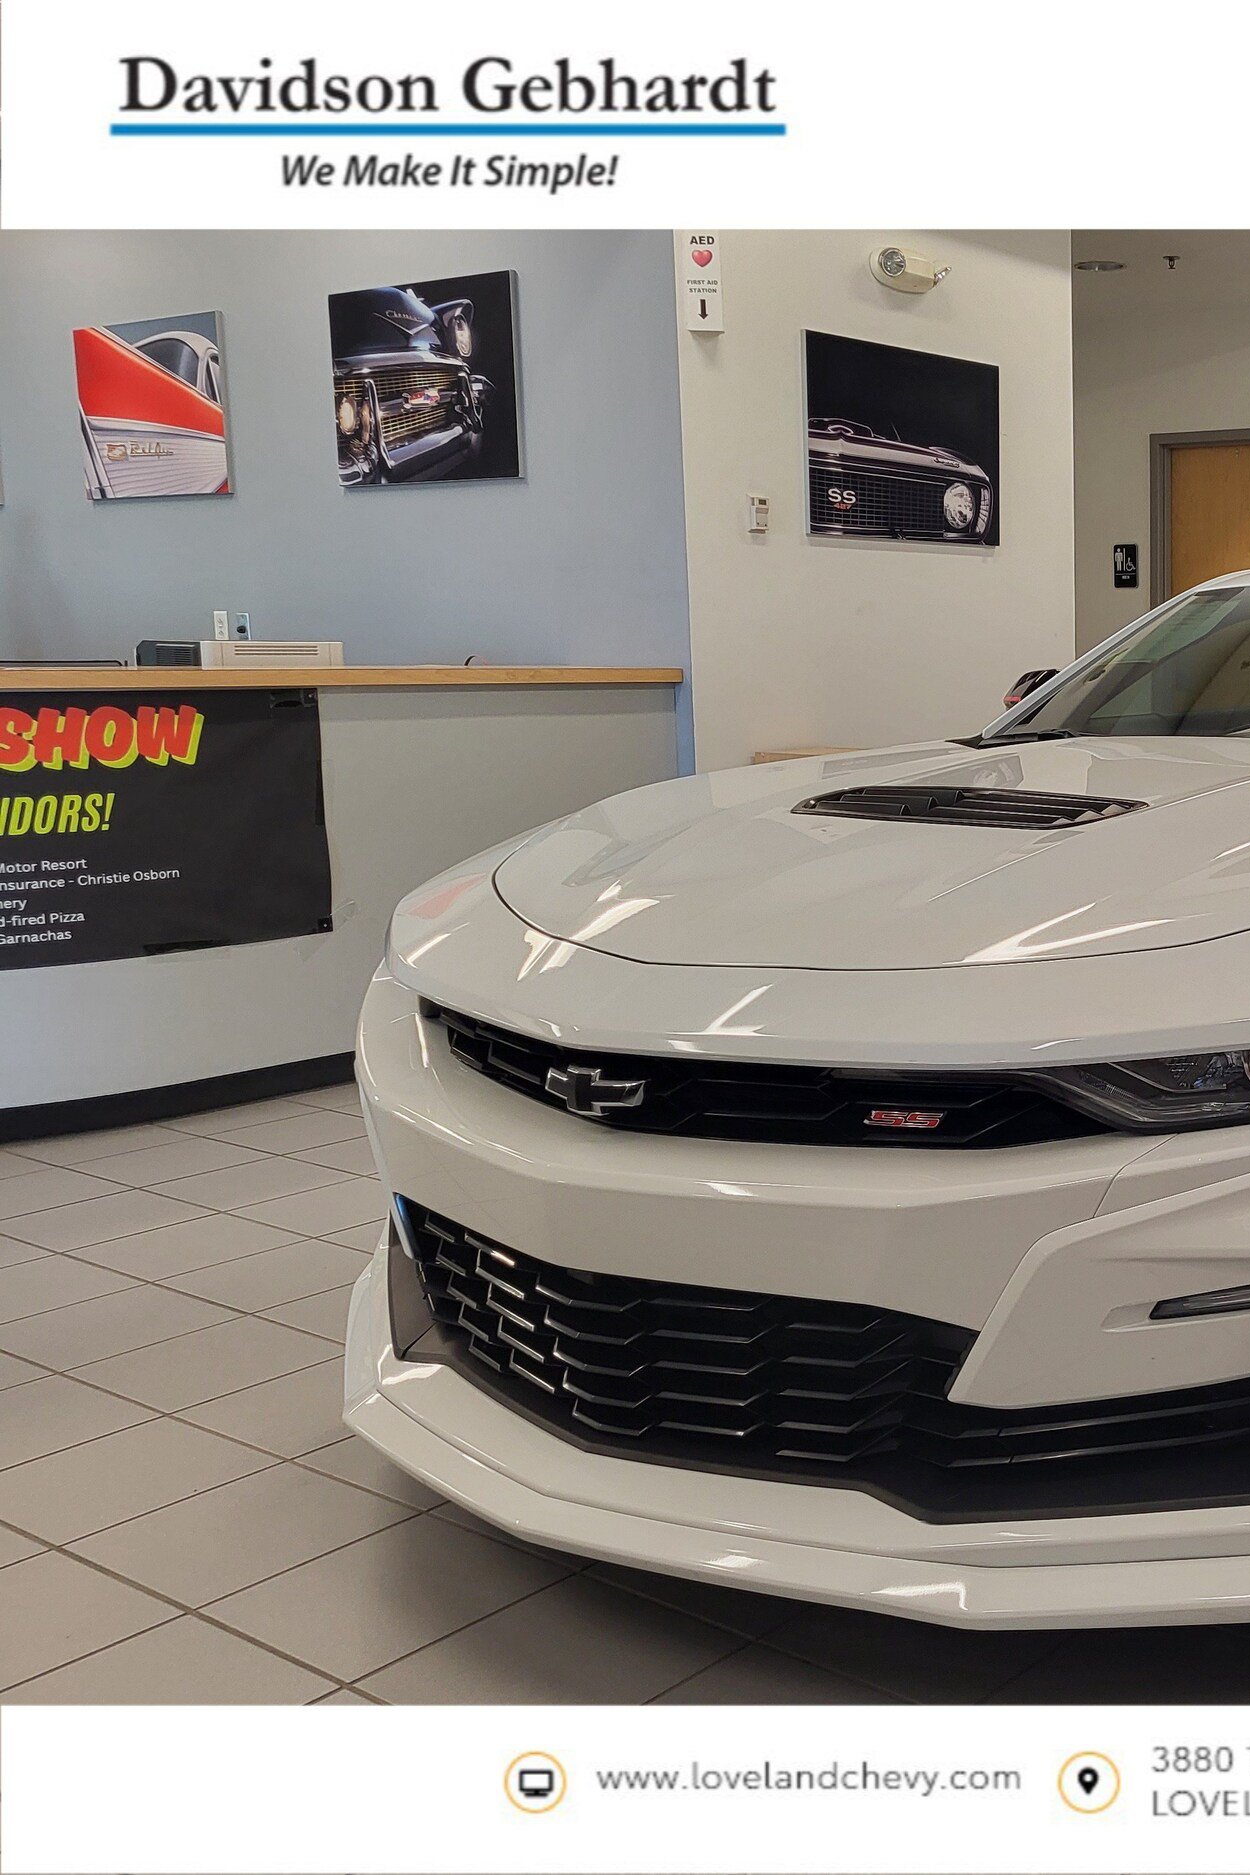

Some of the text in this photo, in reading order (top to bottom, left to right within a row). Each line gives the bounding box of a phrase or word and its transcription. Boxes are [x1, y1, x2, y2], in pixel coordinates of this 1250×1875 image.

[690, 236, 715, 245] AED
[828, 488, 856, 504] SS
[0, 705, 204, 772] SHOW
[41, 858, 87, 871] Resort
[78, 872, 130, 887] Christie
[133, 869, 180, 882] Osborn
[50, 912, 85, 923] Pizza
[0, 930, 72, 944] Garnachas
[863, 1110, 944, 1128] SS
